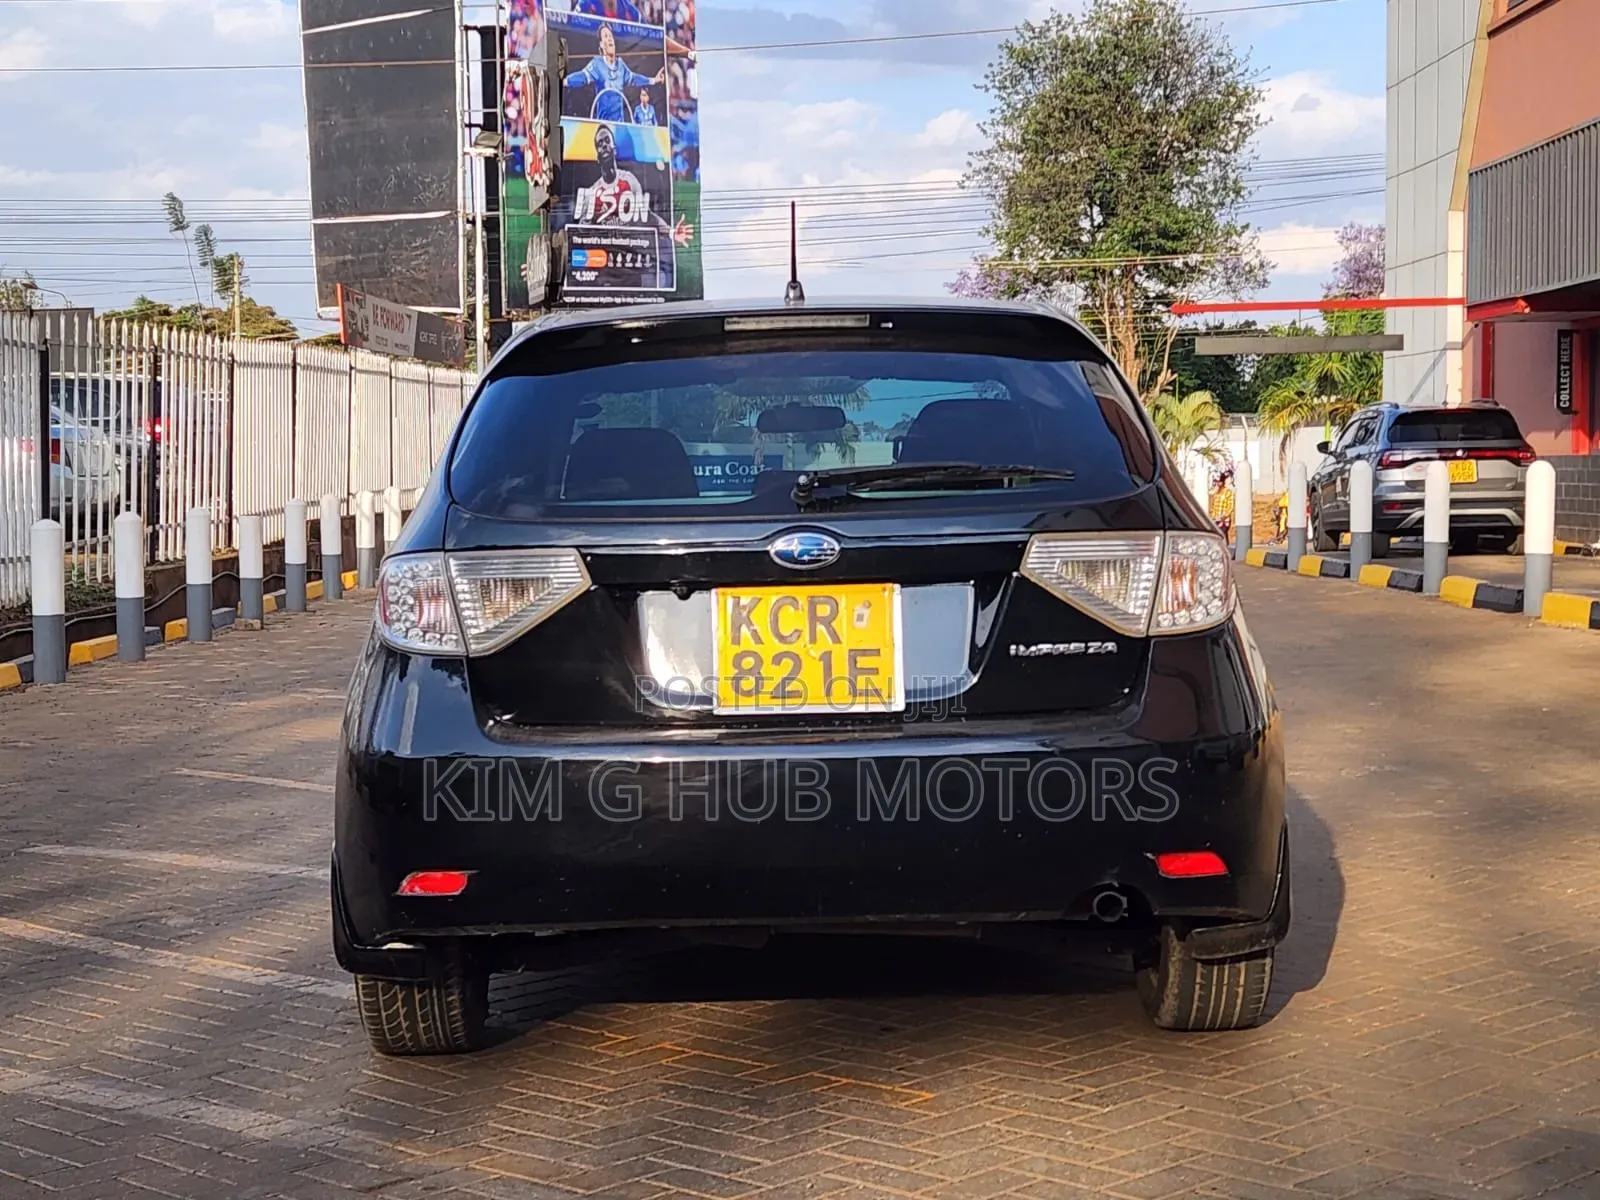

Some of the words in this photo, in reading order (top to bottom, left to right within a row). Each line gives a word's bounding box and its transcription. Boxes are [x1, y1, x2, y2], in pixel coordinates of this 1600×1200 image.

[618, 191, 650, 223] ON
[1560, 336, 1570, 363] HERE
[1560, 364, 1570, 408] COLLECT
[693, 465, 722, 476] ura
[730, 594, 843, 647] KCR
[730, 648, 882, 699] 821E
